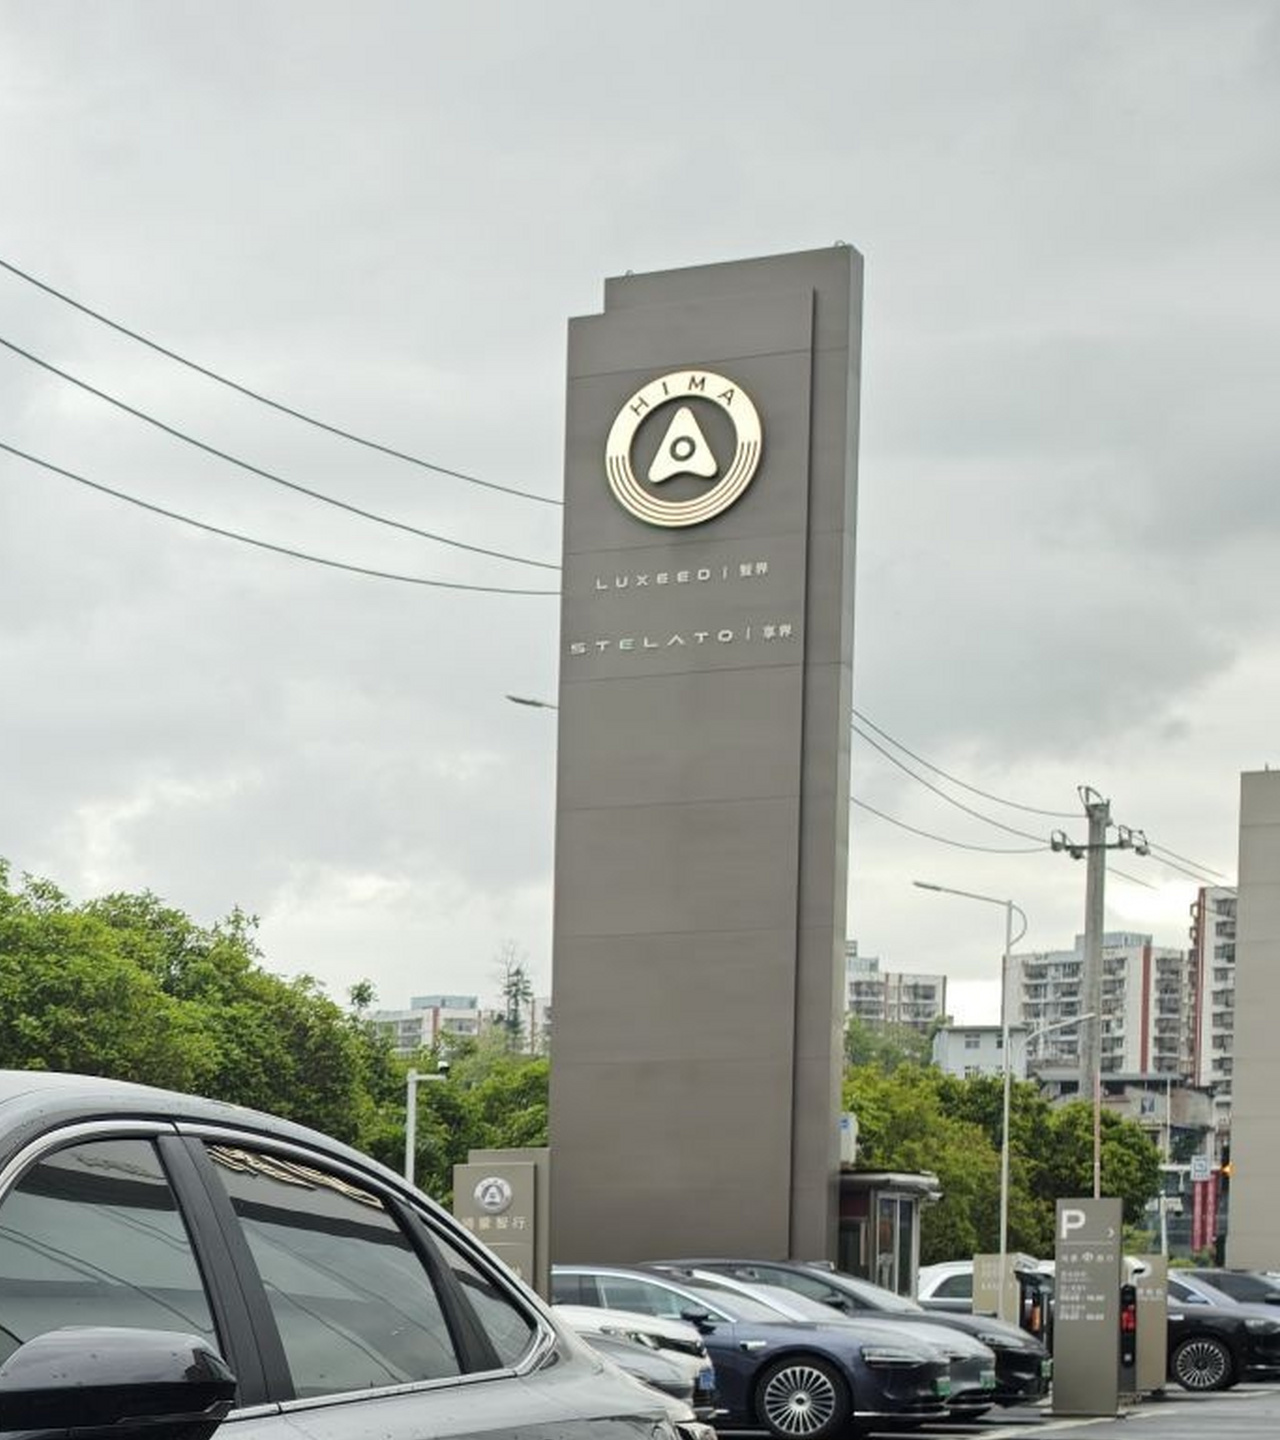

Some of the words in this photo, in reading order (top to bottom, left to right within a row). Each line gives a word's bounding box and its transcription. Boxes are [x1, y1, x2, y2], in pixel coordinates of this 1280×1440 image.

[629, 375, 735, 417] HIMA
[596, 569, 710, 590] LUXEED
[570, 629, 733, 655] STELATO
[1061, 1209, 1086, 1239] P
